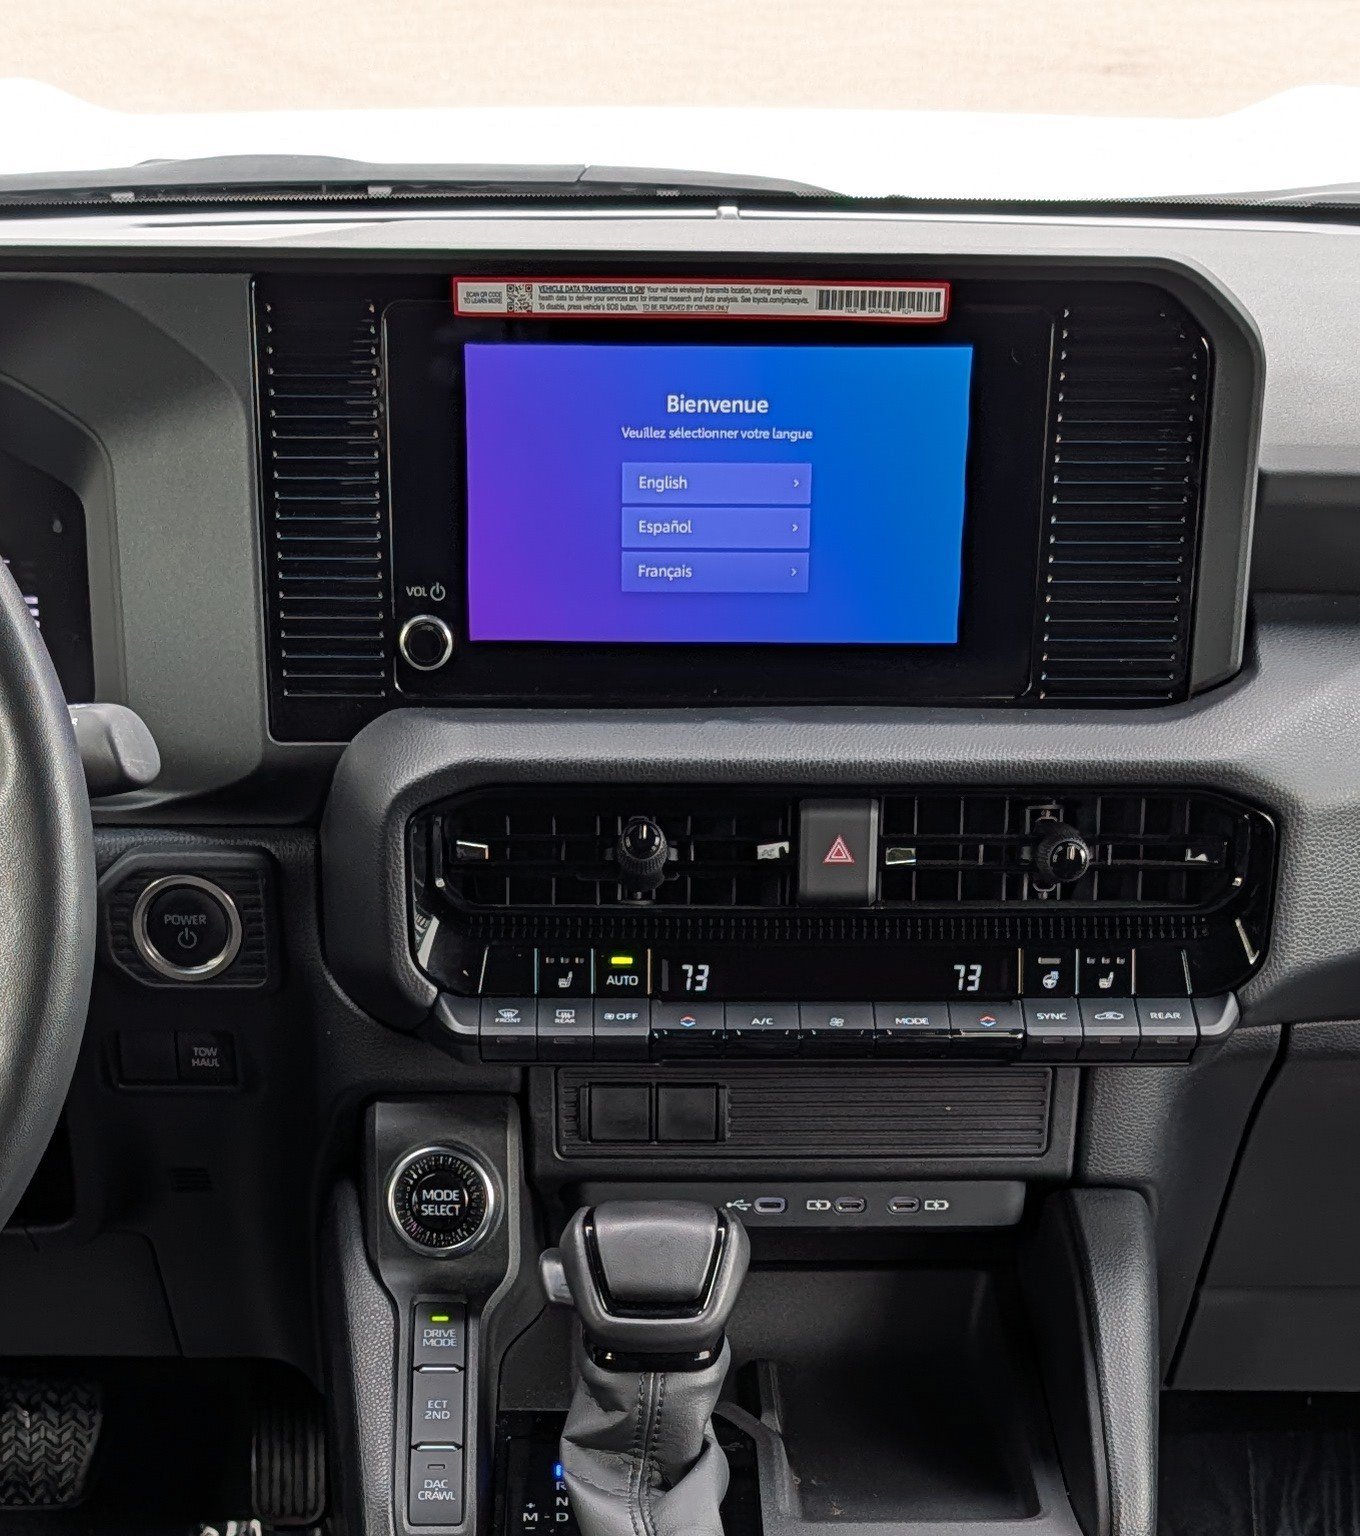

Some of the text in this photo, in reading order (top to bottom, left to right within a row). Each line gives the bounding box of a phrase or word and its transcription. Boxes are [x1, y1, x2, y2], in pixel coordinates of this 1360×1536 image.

[565, 285, 580, 293] DATA
[581, 285, 626, 293] TRANSMISSION
[679, 287, 705, 295] wirelessly
[754, 287, 771, 295] driving
[666, 394, 769, 414] Bienvenue
[621, 426, 813, 443] Veuillez sélectionner votre langue
[638, 475, 688, 492] English
[638, 519, 692, 536] Español
[638, 564, 692, 580] Français
[406, 586, 427, 597] VOL
[164, 914, 207, 925] POWER
[606, 975, 639, 986] AUTO
[681, 964, 710, 991] 73
[953, 964, 982, 991] 73
[616, 1013, 639, 1021] OFF
[1036, 1012, 1068, 1021] SYNC
[1149, 1011, 1181, 1020] REAR
[751, 1017, 774, 1026] A/C
[895, 1017, 930, 1025] MODE
[193, 1046, 218, 1057] TOW
[191, 1057, 220, 1067] HAUL
[422, 1189, 460, 1201] MODE
[421, 1204, 460, 1216] SELECT
[423, 1329, 456, 1338] DRIVE
[422, 1338, 457, 1347] MODE
[427, 1400, 448, 1409] ECT
[424, 1410, 450, 1420] 2ND
[424, 1479, 448, 1489] DAC
[556, 1481, 566, 1490] R
[418, 1490, 455, 1500] CRAWL
[556, 1497, 569, 1506] N
[522, 1512, 538, 1522] M
[556, 1512, 569, 1522] D
